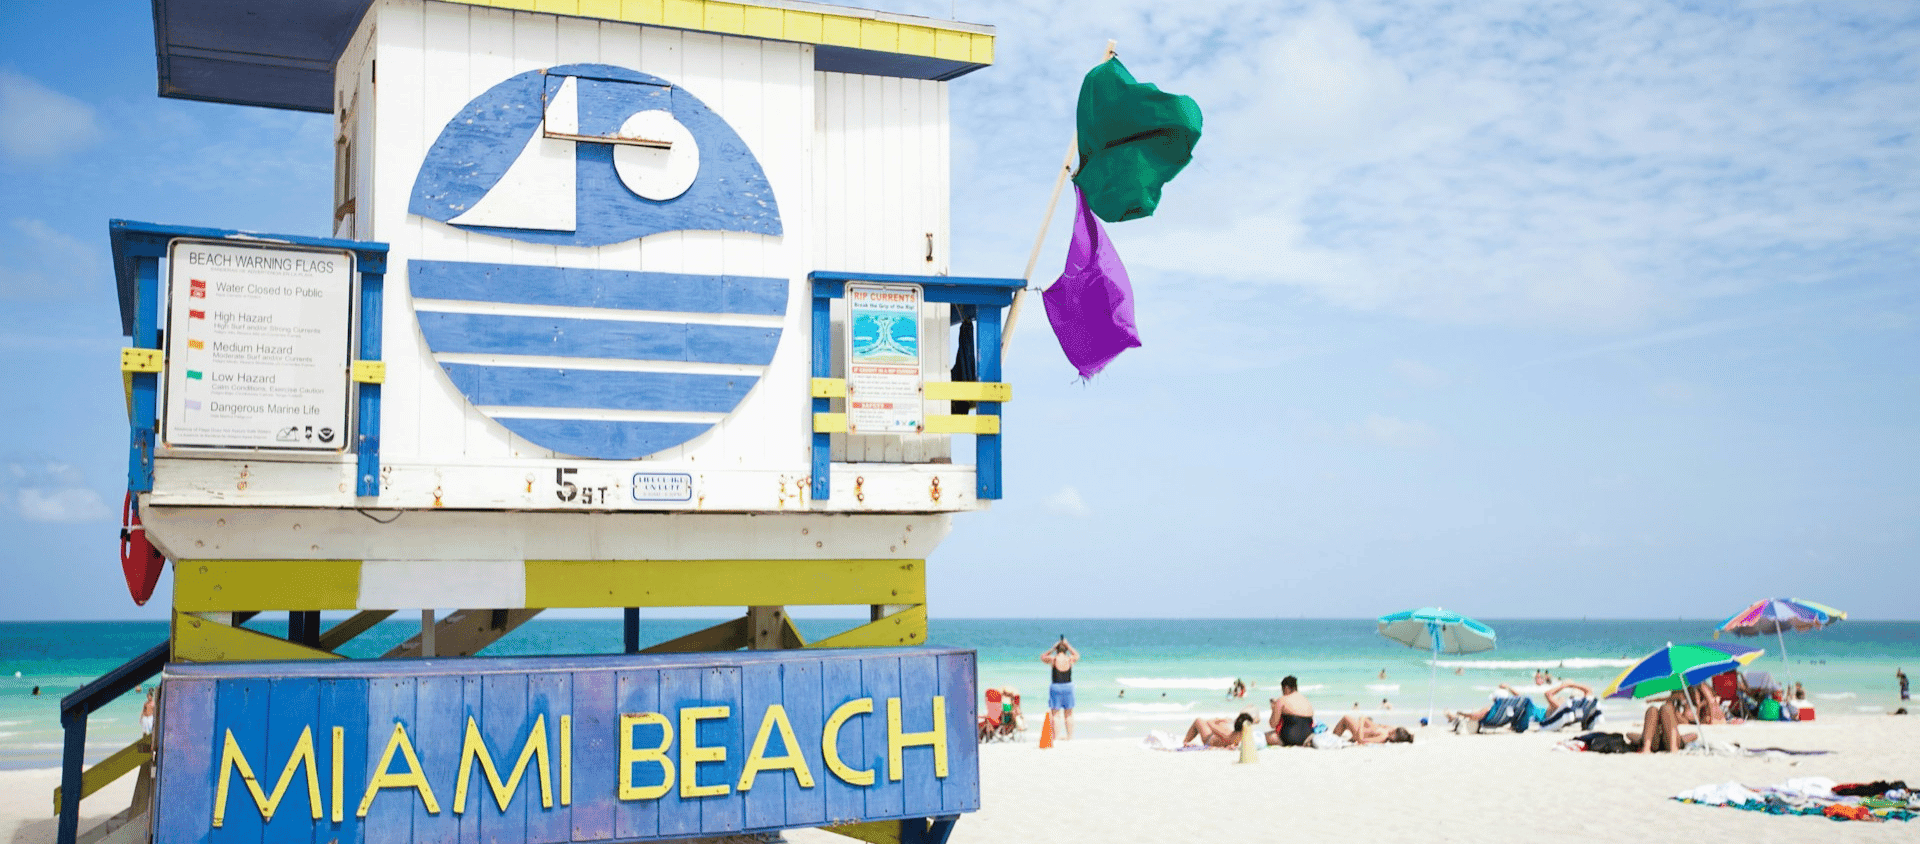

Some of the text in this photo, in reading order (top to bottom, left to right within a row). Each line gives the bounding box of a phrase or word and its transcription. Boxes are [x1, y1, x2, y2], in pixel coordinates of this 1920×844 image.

[189, 252, 334, 274] BEACH WARNING FLAGS
[216, 282, 323, 298] Water Closed to Public
[854, 292, 916, 302] RIP CURRENTS
[214, 311, 273, 324] High Hazard
[214, 323, 227, 331] High
[269, 325, 291, 333] Strong
[213, 341, 293, 355] Medium Hazard
[285, 355, 313, 363] Currents
[211, 371, 276, 384] Low Hazard
[210, 401, 320, 415] Dangerous Marine Life
[556, 468, 577, 502] 5
[212, 695, 949, 828] MIAMI BEACH
